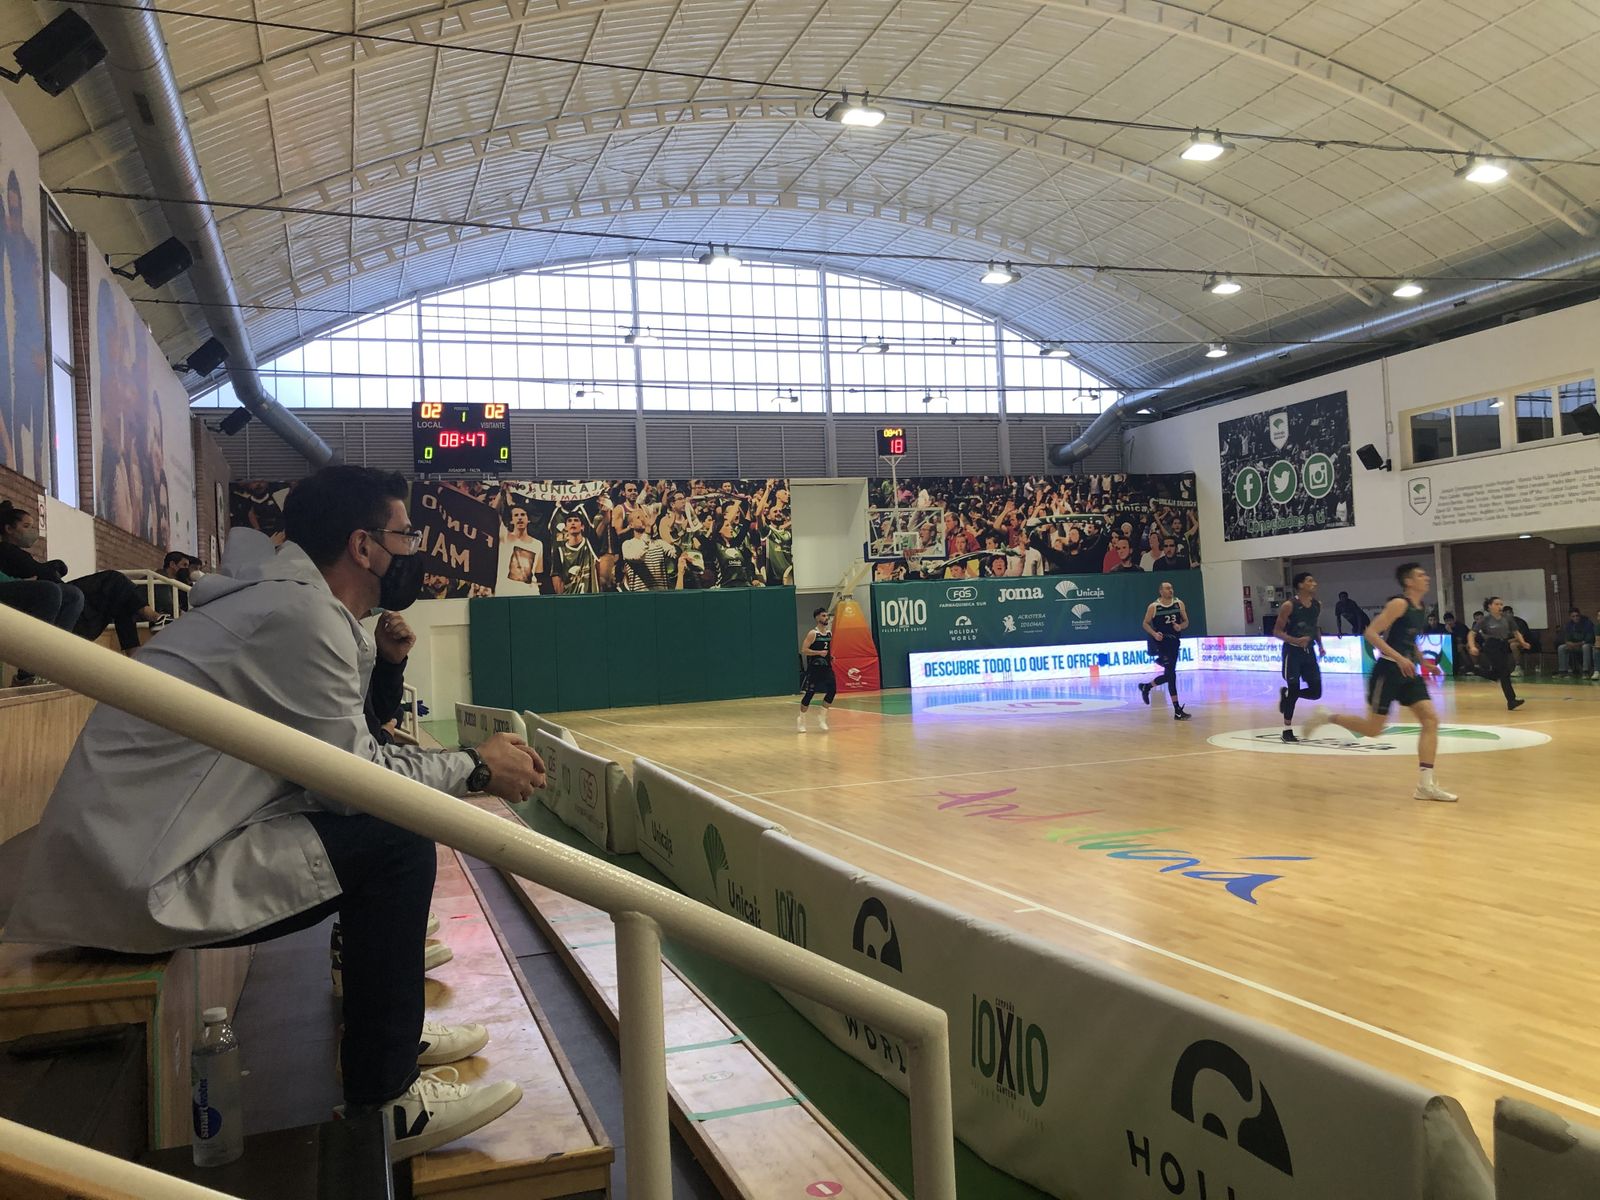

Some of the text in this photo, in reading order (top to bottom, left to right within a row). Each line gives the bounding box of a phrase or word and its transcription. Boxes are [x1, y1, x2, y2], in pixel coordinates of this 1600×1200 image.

[421, 403, 442, 419] 02
[461, 411, 466, 423] 1
[485, 404, 505, 419] 02
[417, 421, 442, 429] LOCAL
[481, 421, 505, 430] VISITANTE
[439, 432, 486, 448] 08:47
[424, 447, 433, 459] 0
[500, 447, 508, 459] 0
[1076, 587, 1105, 598] Unicaja
[1164, 614, 1177, 624] 23
[924, 659, 981, 678] DESCUBRE
[983, 657, 1012, 674] TODO
[1014, 656, 1027, 672] LO
[1029, 655, 1050, 671] QUE
[1051, 654, 1065, 670] TE
[1067, 652, 1102, 669] OFREC
[1108, 651, 1120, 666] LA
